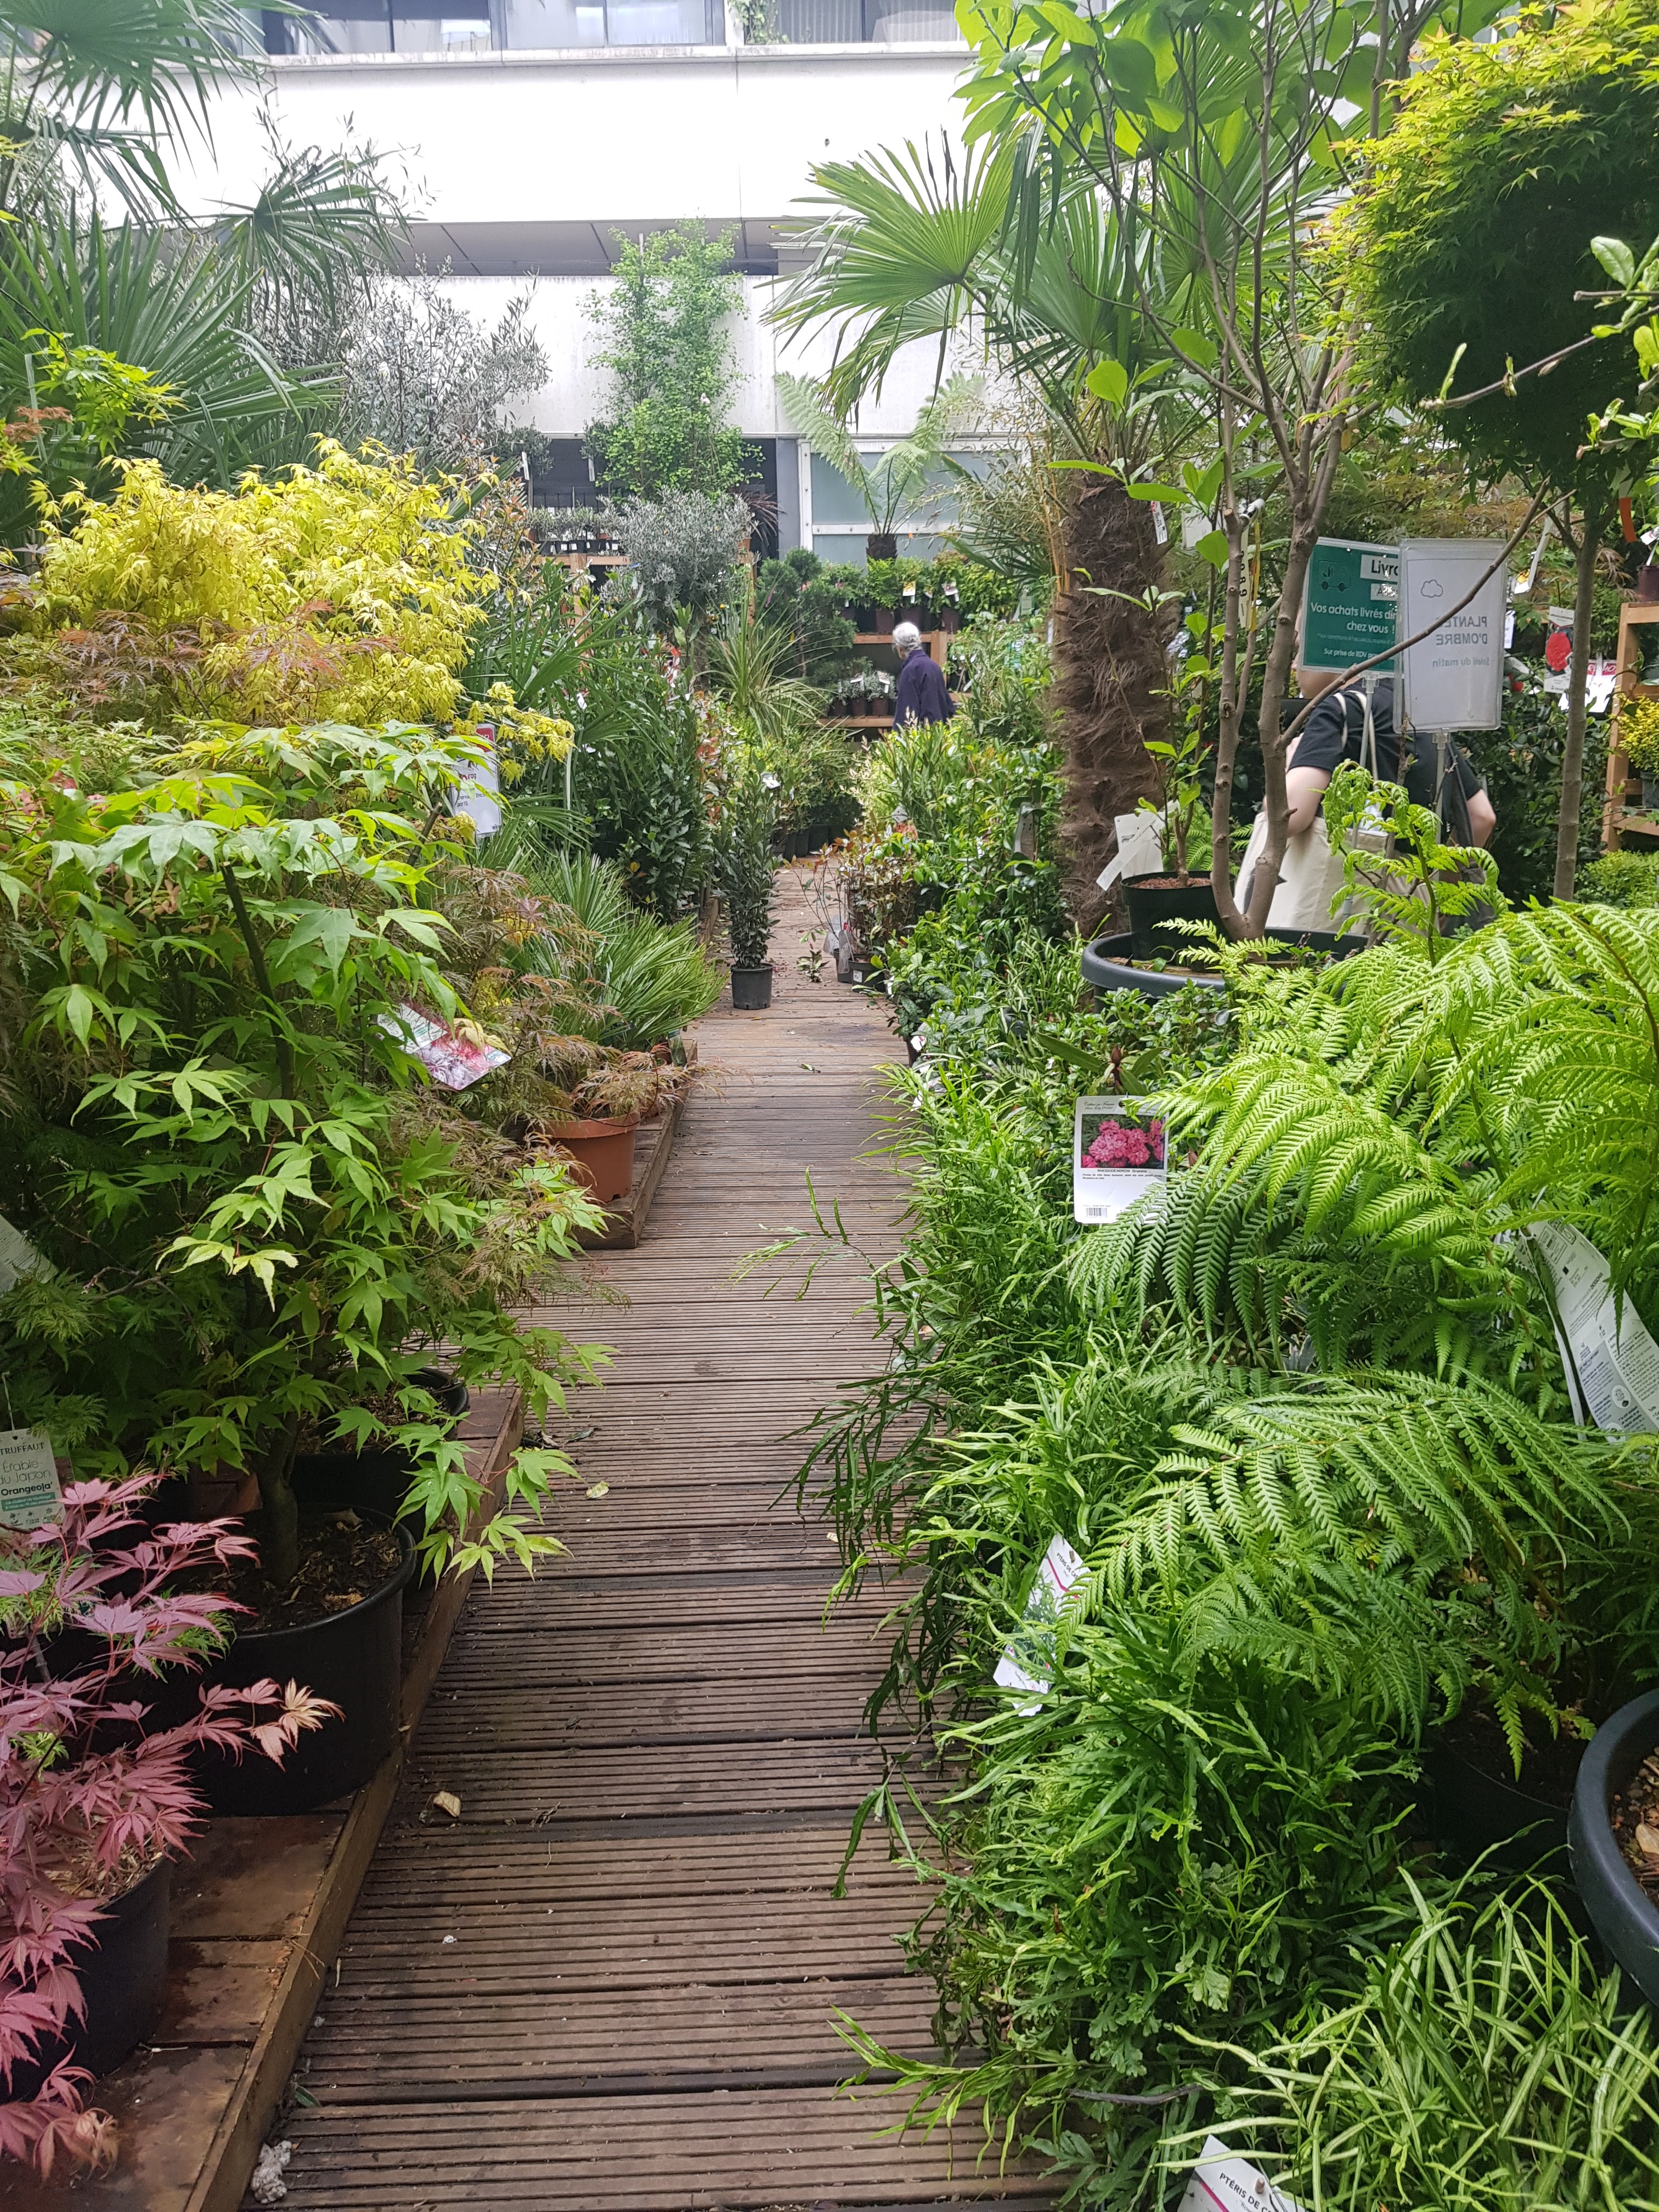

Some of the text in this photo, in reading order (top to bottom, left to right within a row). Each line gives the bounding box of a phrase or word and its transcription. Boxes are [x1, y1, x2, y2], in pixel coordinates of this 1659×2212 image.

[1311, 602, 1327, 613] Vos
[1329, 605, 1358, 616] achats
[1360, 607, 1383, 619] livrés
[1347, 620, 1367, 631] chez
[1368, 624, 1389, 634] vous
[0, 1442, 44, 1455] TRUFFAUT
[3, 1460, 39, 1472] Érable
[16, 1470, 51, 1483] Japon
[1220, 2172, 1247, 2198] PTÉRIS
[1248, 2196, 1260, 2210] DE
